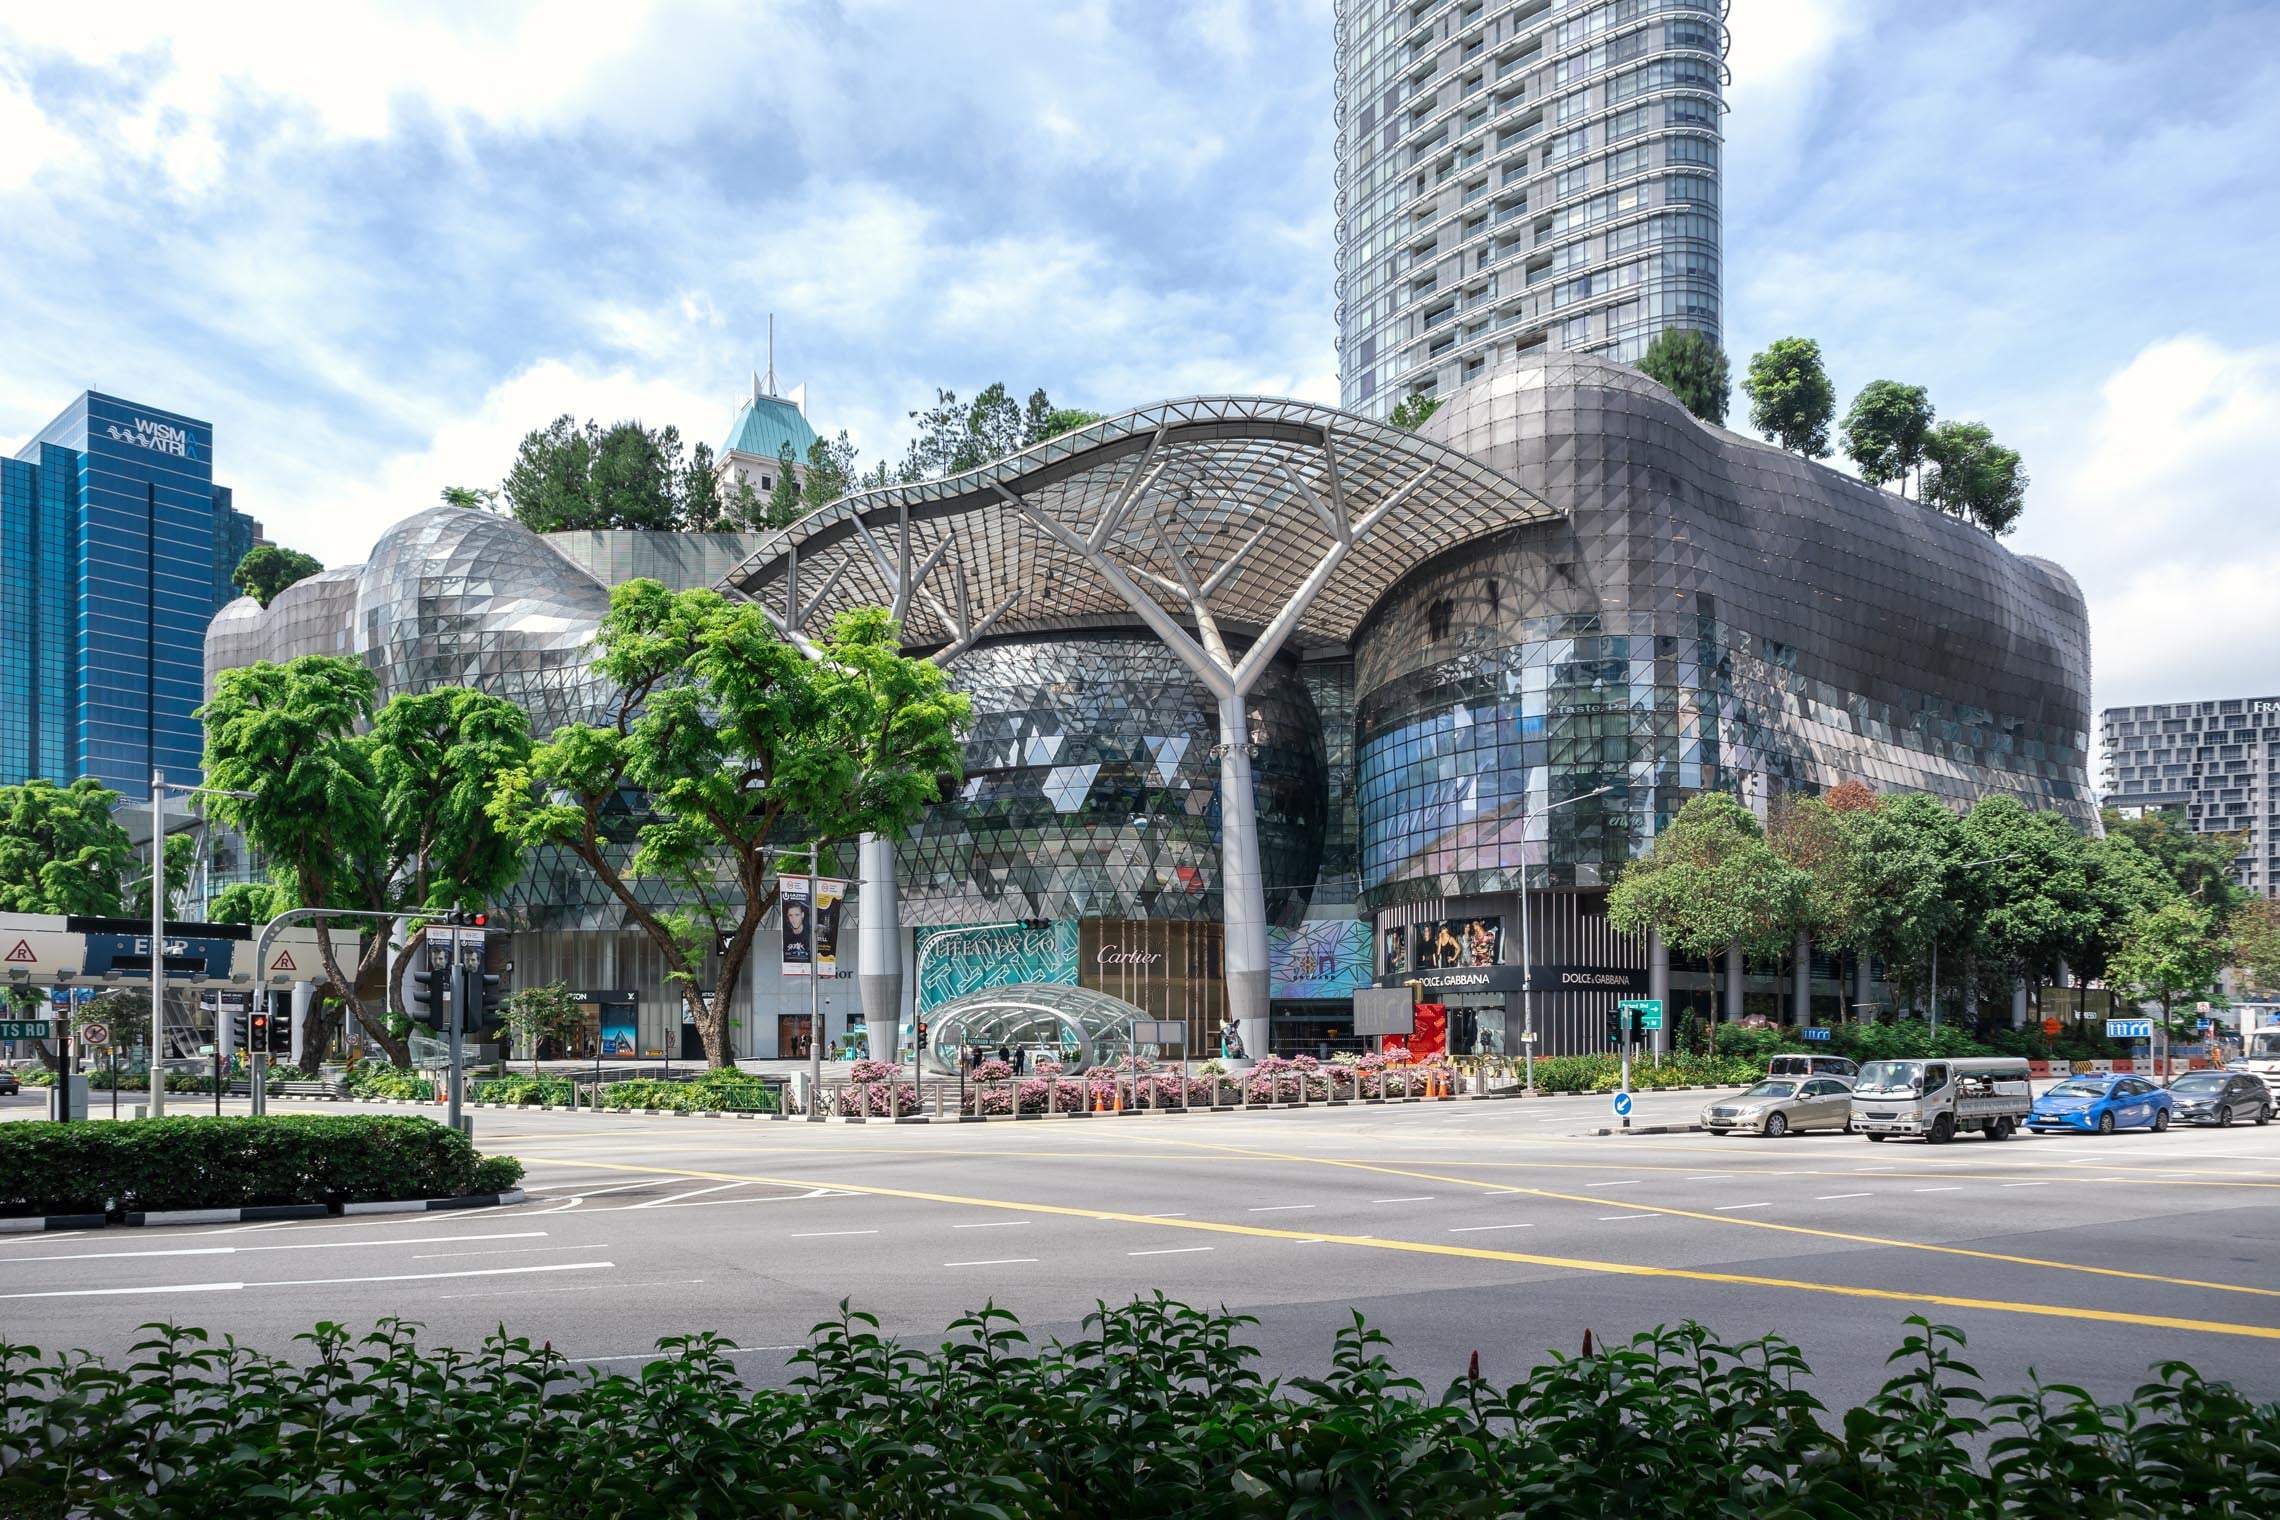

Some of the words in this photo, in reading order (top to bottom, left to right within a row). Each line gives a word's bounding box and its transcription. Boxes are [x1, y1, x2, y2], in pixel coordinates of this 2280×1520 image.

[134, 417, 197, 446] WISMA
[149, 436, 198, 460] ATRIA
[1558, 703, 1600, 714] Taste
[1608, 702, 1676, 713] Paadse
[2254, 701, 2280, 713] FRA
[17, 948, 27, 959] R
[1097, 944, 1162, 964] Cartier
[281, 958, 289, 968] R
[1, 1023, 20, 1037] TS
[25, 1023, 46, 1037] RD
